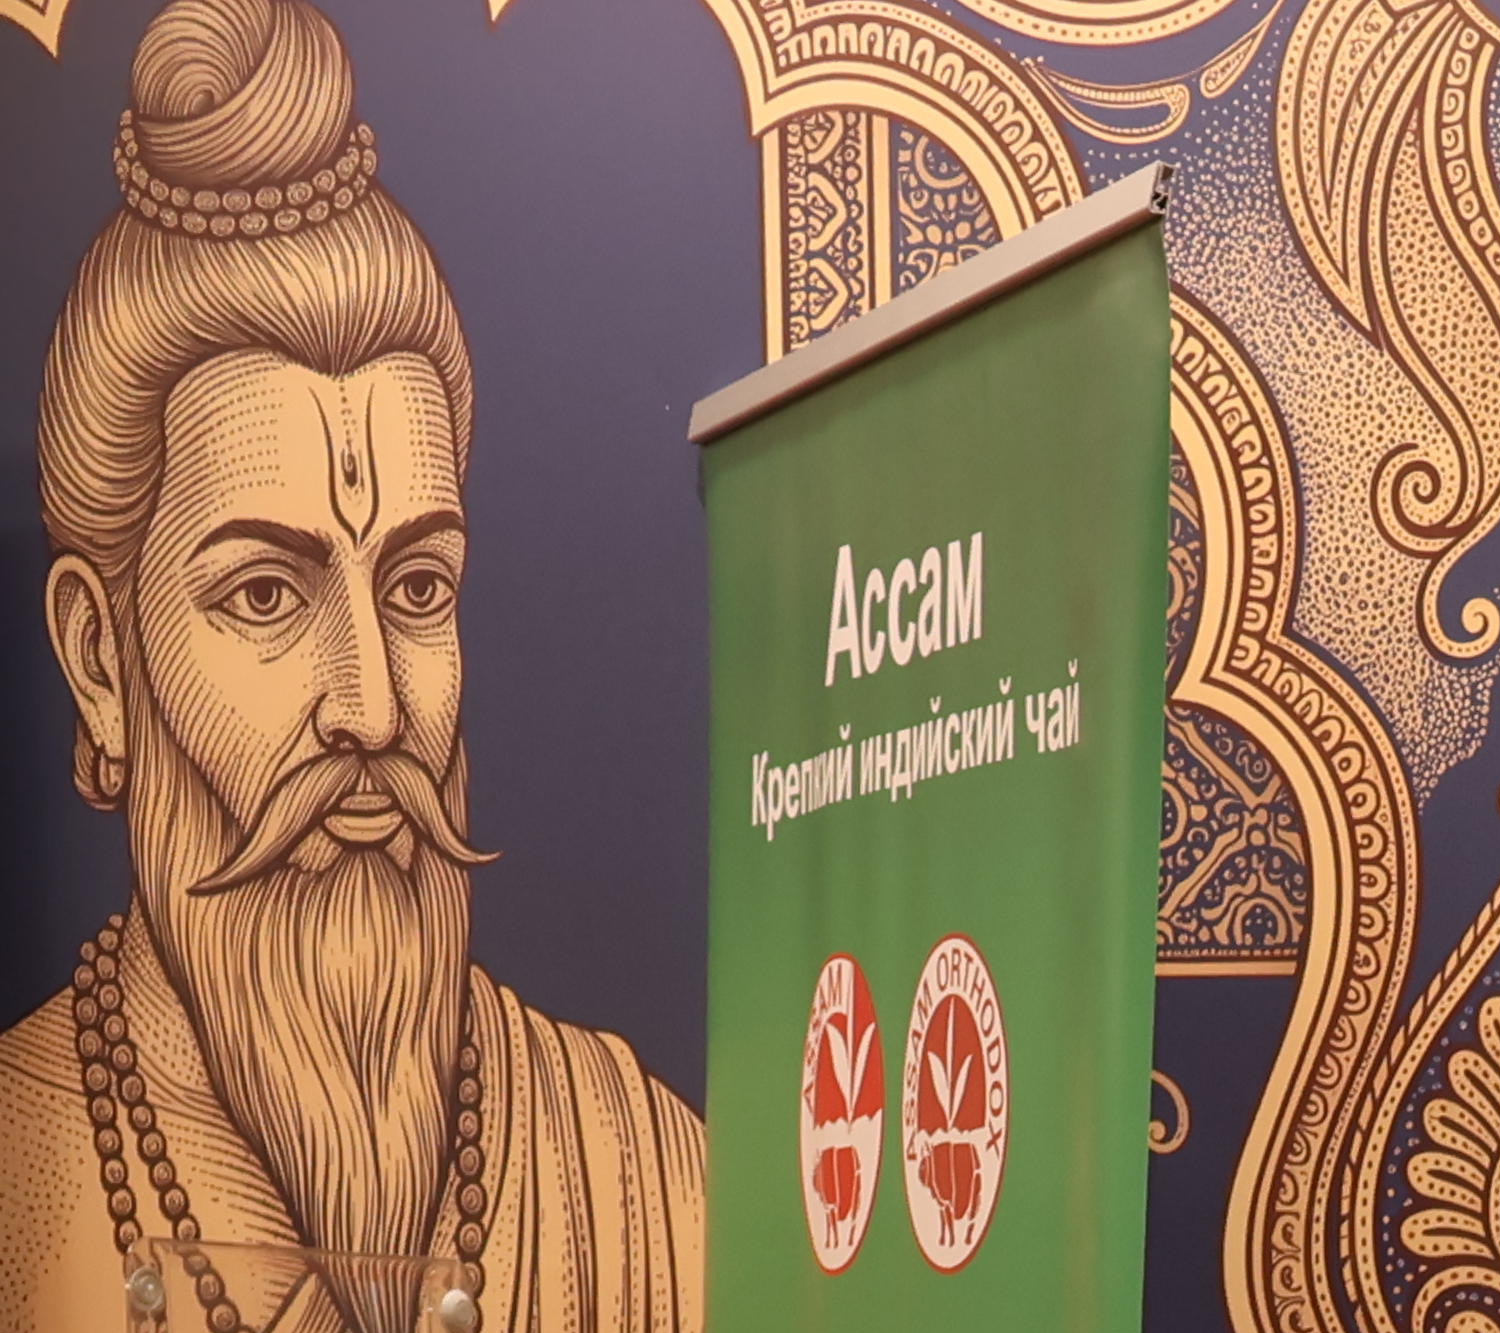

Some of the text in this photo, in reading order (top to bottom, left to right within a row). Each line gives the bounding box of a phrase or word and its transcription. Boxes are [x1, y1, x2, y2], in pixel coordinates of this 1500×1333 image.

[825, 531, 982, 687] Ассам
[752, 658, 1079, 842] Крепкий индийский чай
[804, 962, 842, 1115] ASSAM
[905, 947, 1004, 1161] ASSAM ORTHODOX
